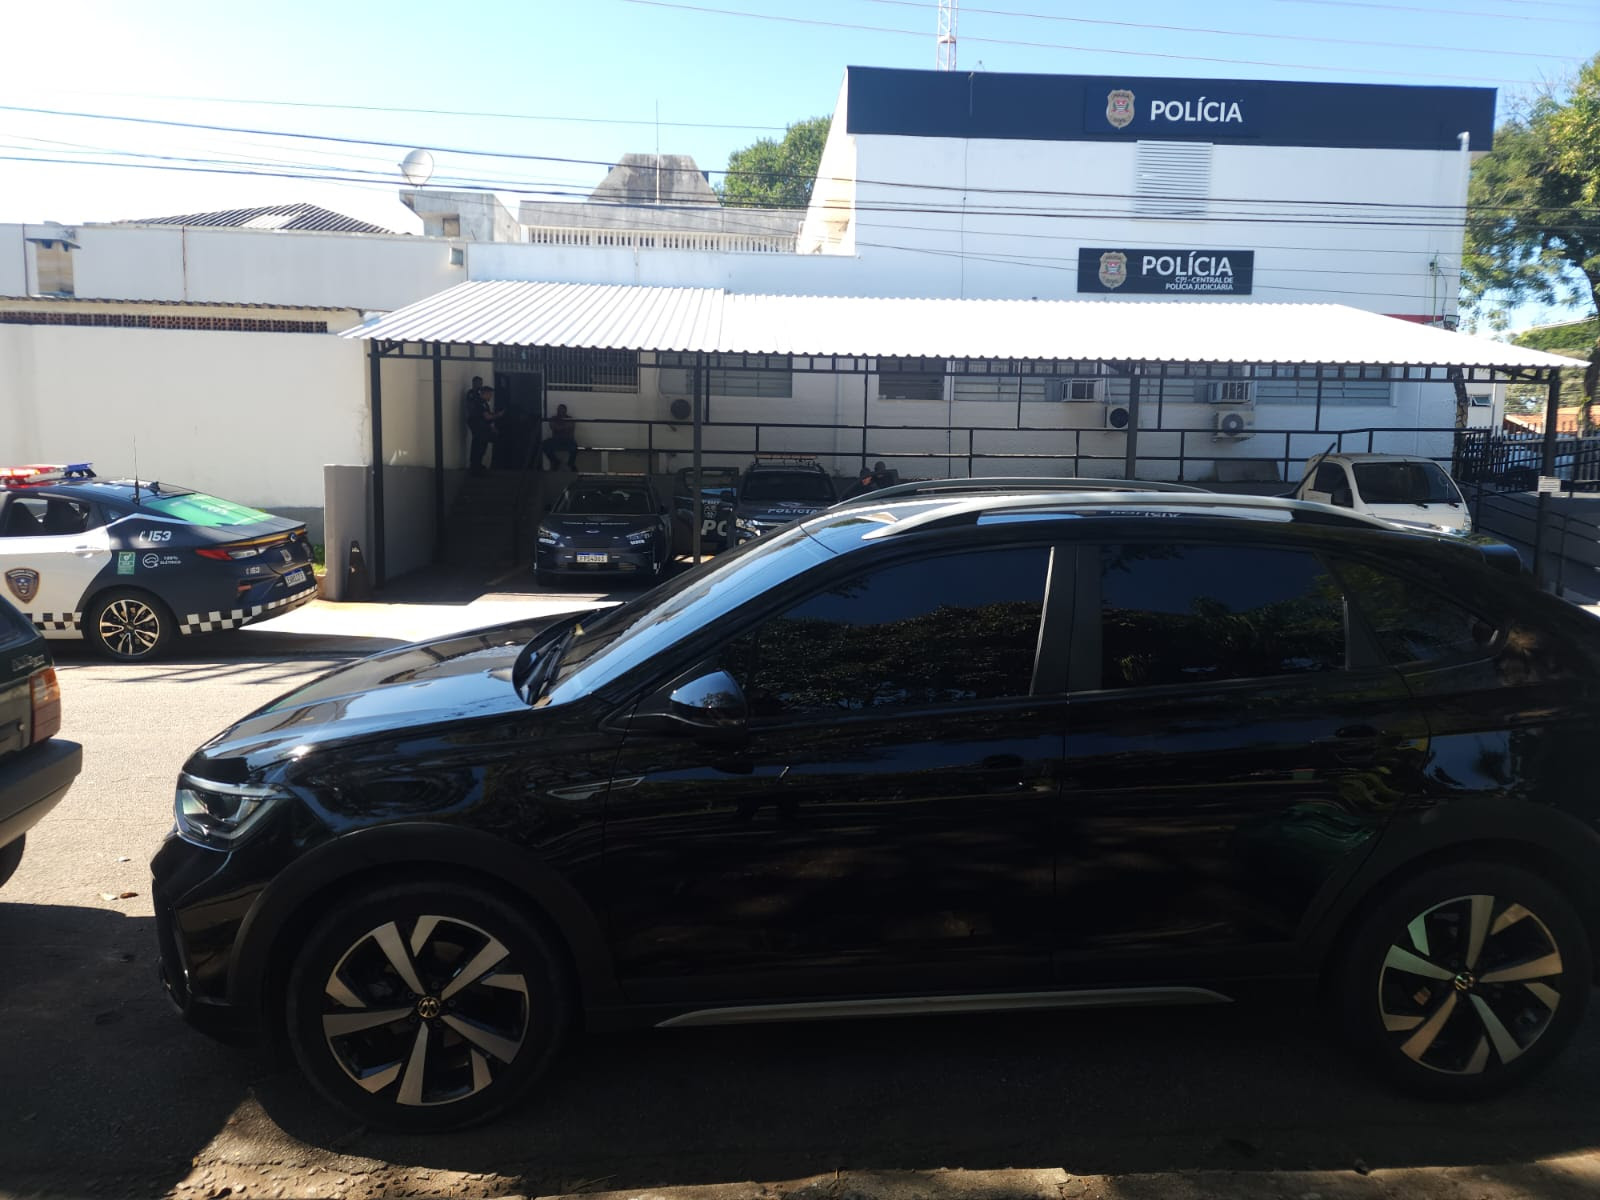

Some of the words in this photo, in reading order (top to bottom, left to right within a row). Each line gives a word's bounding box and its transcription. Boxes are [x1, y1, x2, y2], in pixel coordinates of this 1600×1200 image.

[1151, 97, 1243, 123] POLÍCIA
[1142, 251, 1233, 276] POLÍCIA
[148, 530, 172, 542] 153
